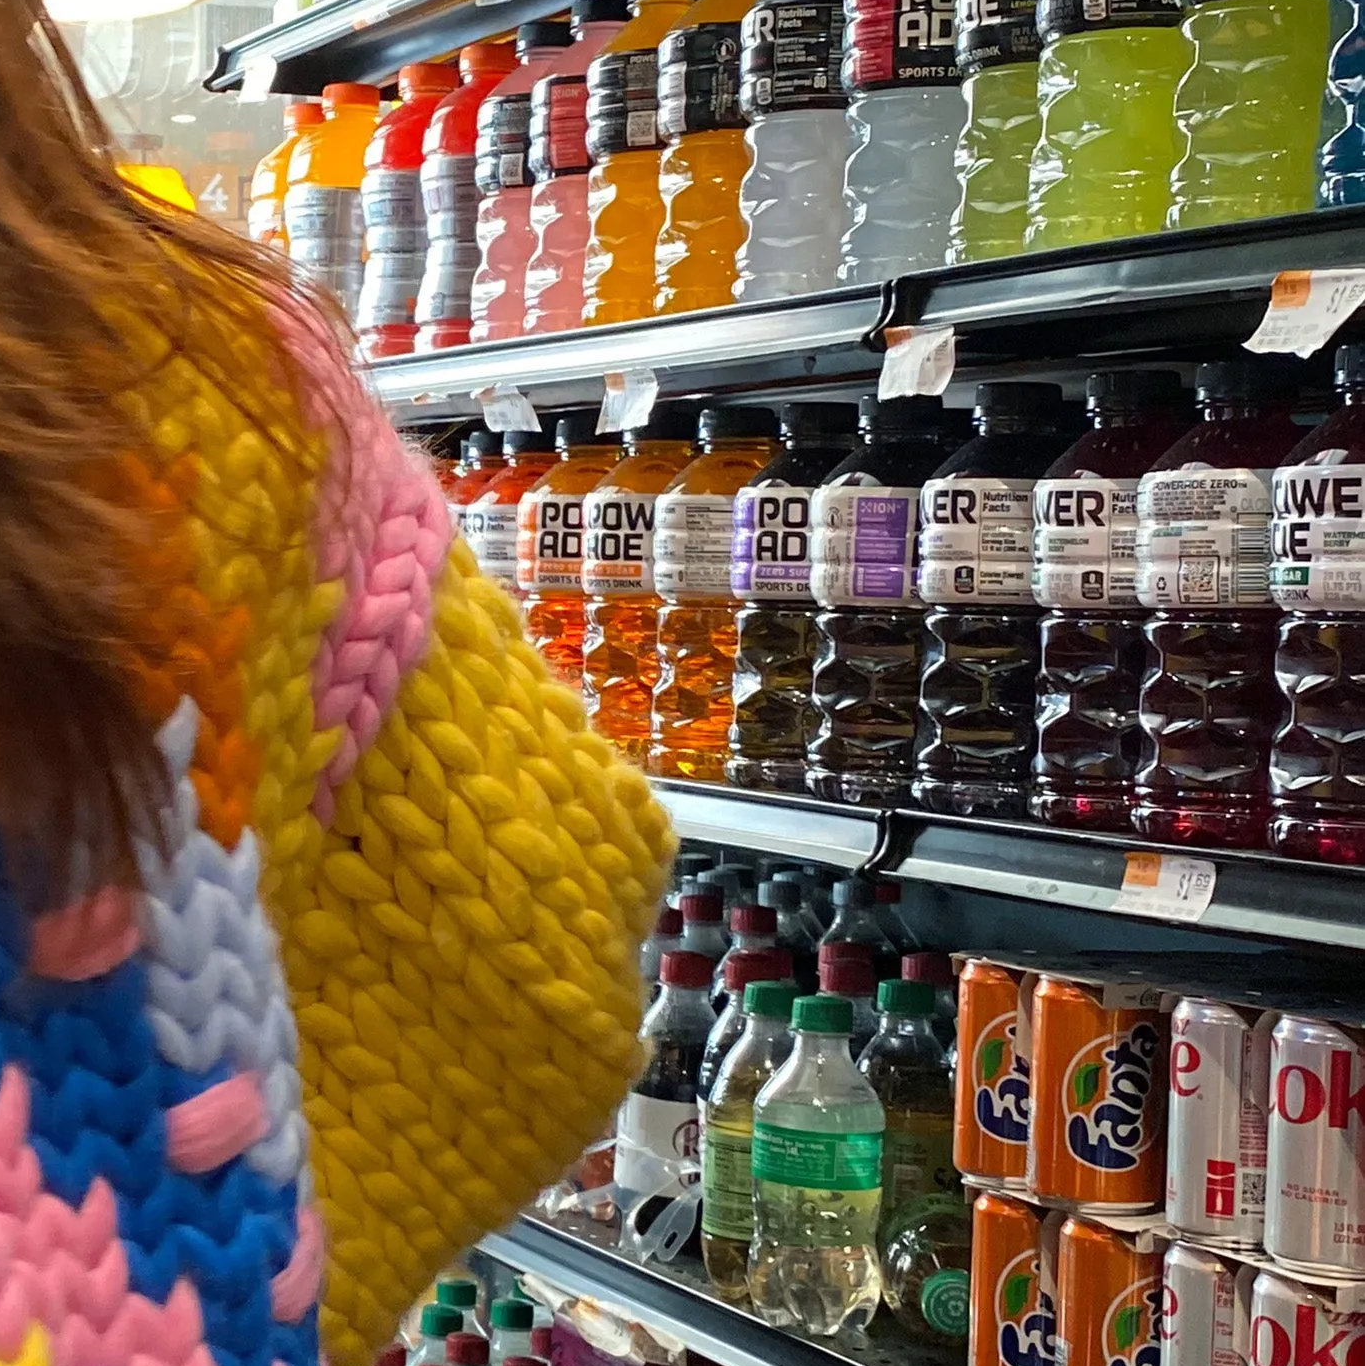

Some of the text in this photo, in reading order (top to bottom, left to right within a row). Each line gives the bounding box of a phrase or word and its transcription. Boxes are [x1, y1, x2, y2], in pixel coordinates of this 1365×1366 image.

[778, 7, 817, 18] Nutrition
[778, 18, 803, 28] Facts
[899, 65, 944, 79] SPORTS
[1154, 480, 1208, 491] POWERADE
[983, 492, 1028, 503] Nutrition
[983, 503, 1011, 513] Facts
[1323, 540, 1350, 548] BERRY
[538, 576, 572, 584] SPORTS
[613, 580, 642, 588] DRINK
[756, 581, 793, 592] SPORTS
[1283, 589, 1311, 601] DRINK
[1067, 1022, 1162, 1171] Fanta
